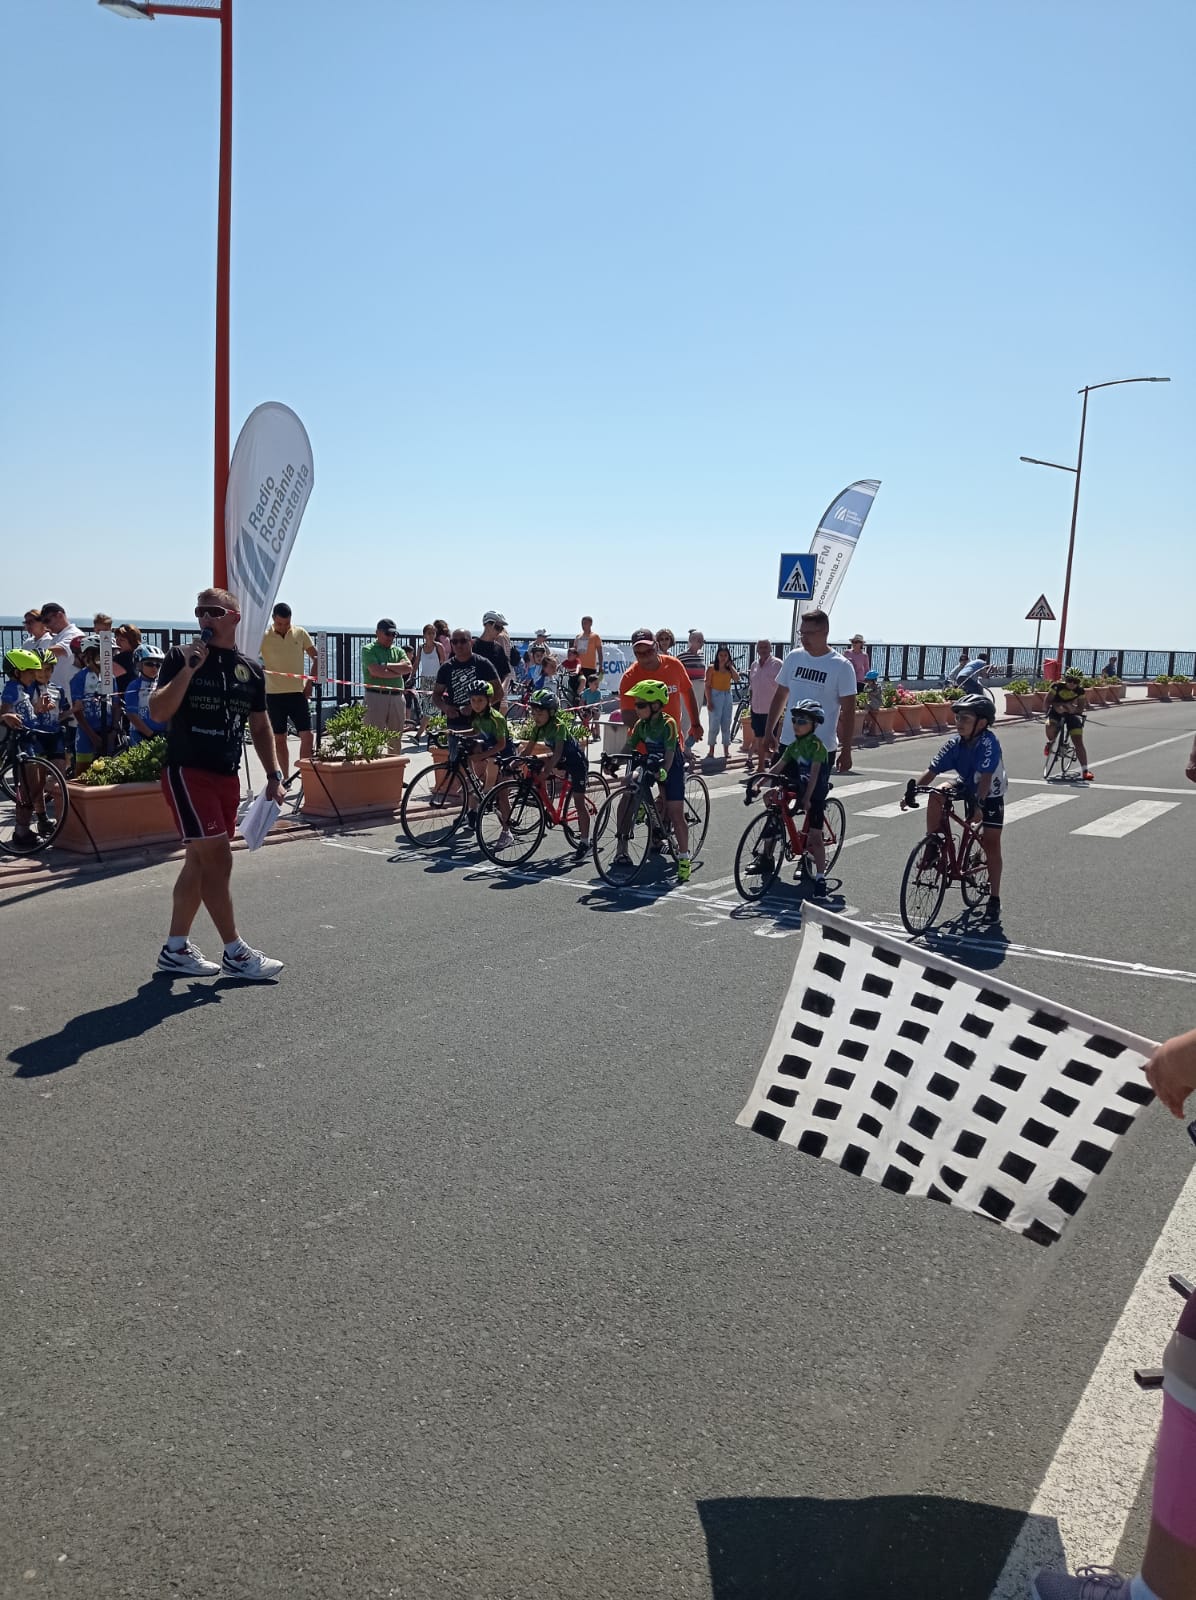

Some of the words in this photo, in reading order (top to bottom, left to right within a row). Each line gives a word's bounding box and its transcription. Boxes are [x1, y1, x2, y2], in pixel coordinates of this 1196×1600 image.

[248, 475, 275, 531] Radio
[259, 463, 295, 543] România
[818, 544, 831, 565] FM
[794, 666, 828, 684] PUMA
